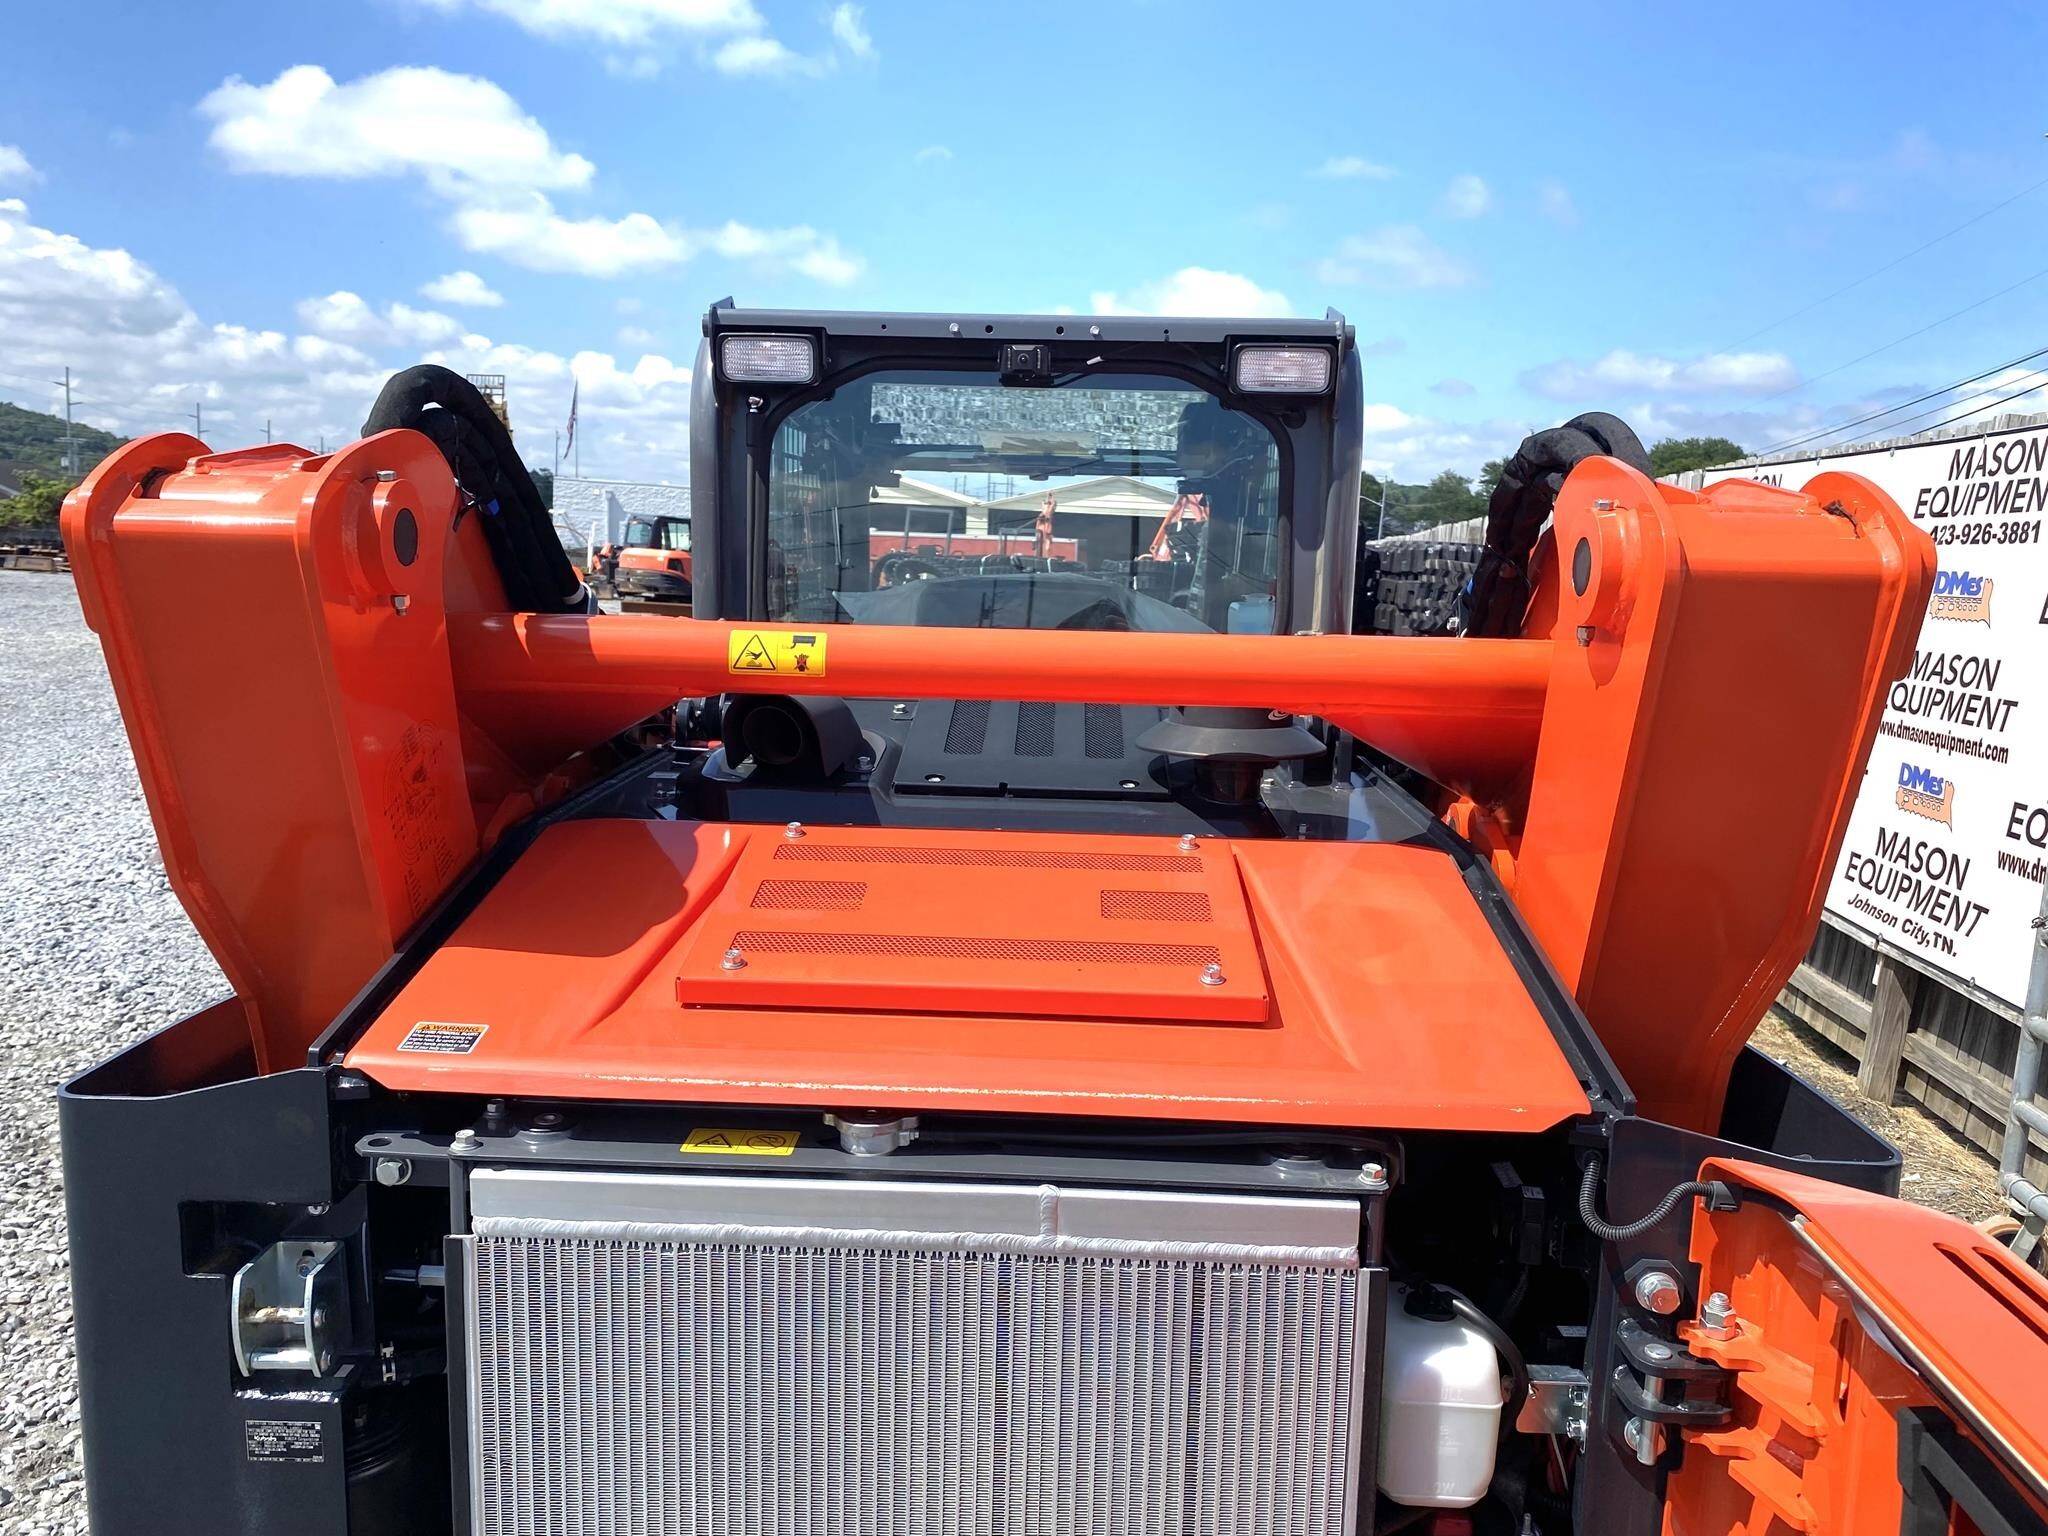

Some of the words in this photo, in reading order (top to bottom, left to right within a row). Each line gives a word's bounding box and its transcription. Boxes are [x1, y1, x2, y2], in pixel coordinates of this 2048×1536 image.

[1948, 436, 2048, 481] MASON
[1914, 477, 2048, 519] EQUIPMEN
[1930, 520, 2042, 546] 423-926-3881
[1907, 651, 2002, 692] MASON
[1884, 682, 2019, 733] QUIPMENT
[1880, 719, 2009, 764] ww.dmasonequipment.com
[1875, 826, 1971, 891] MASON
[1844, 851, 1990, 937] EQUIPMENT
[1848, 893, 1898, 928] Johnson
